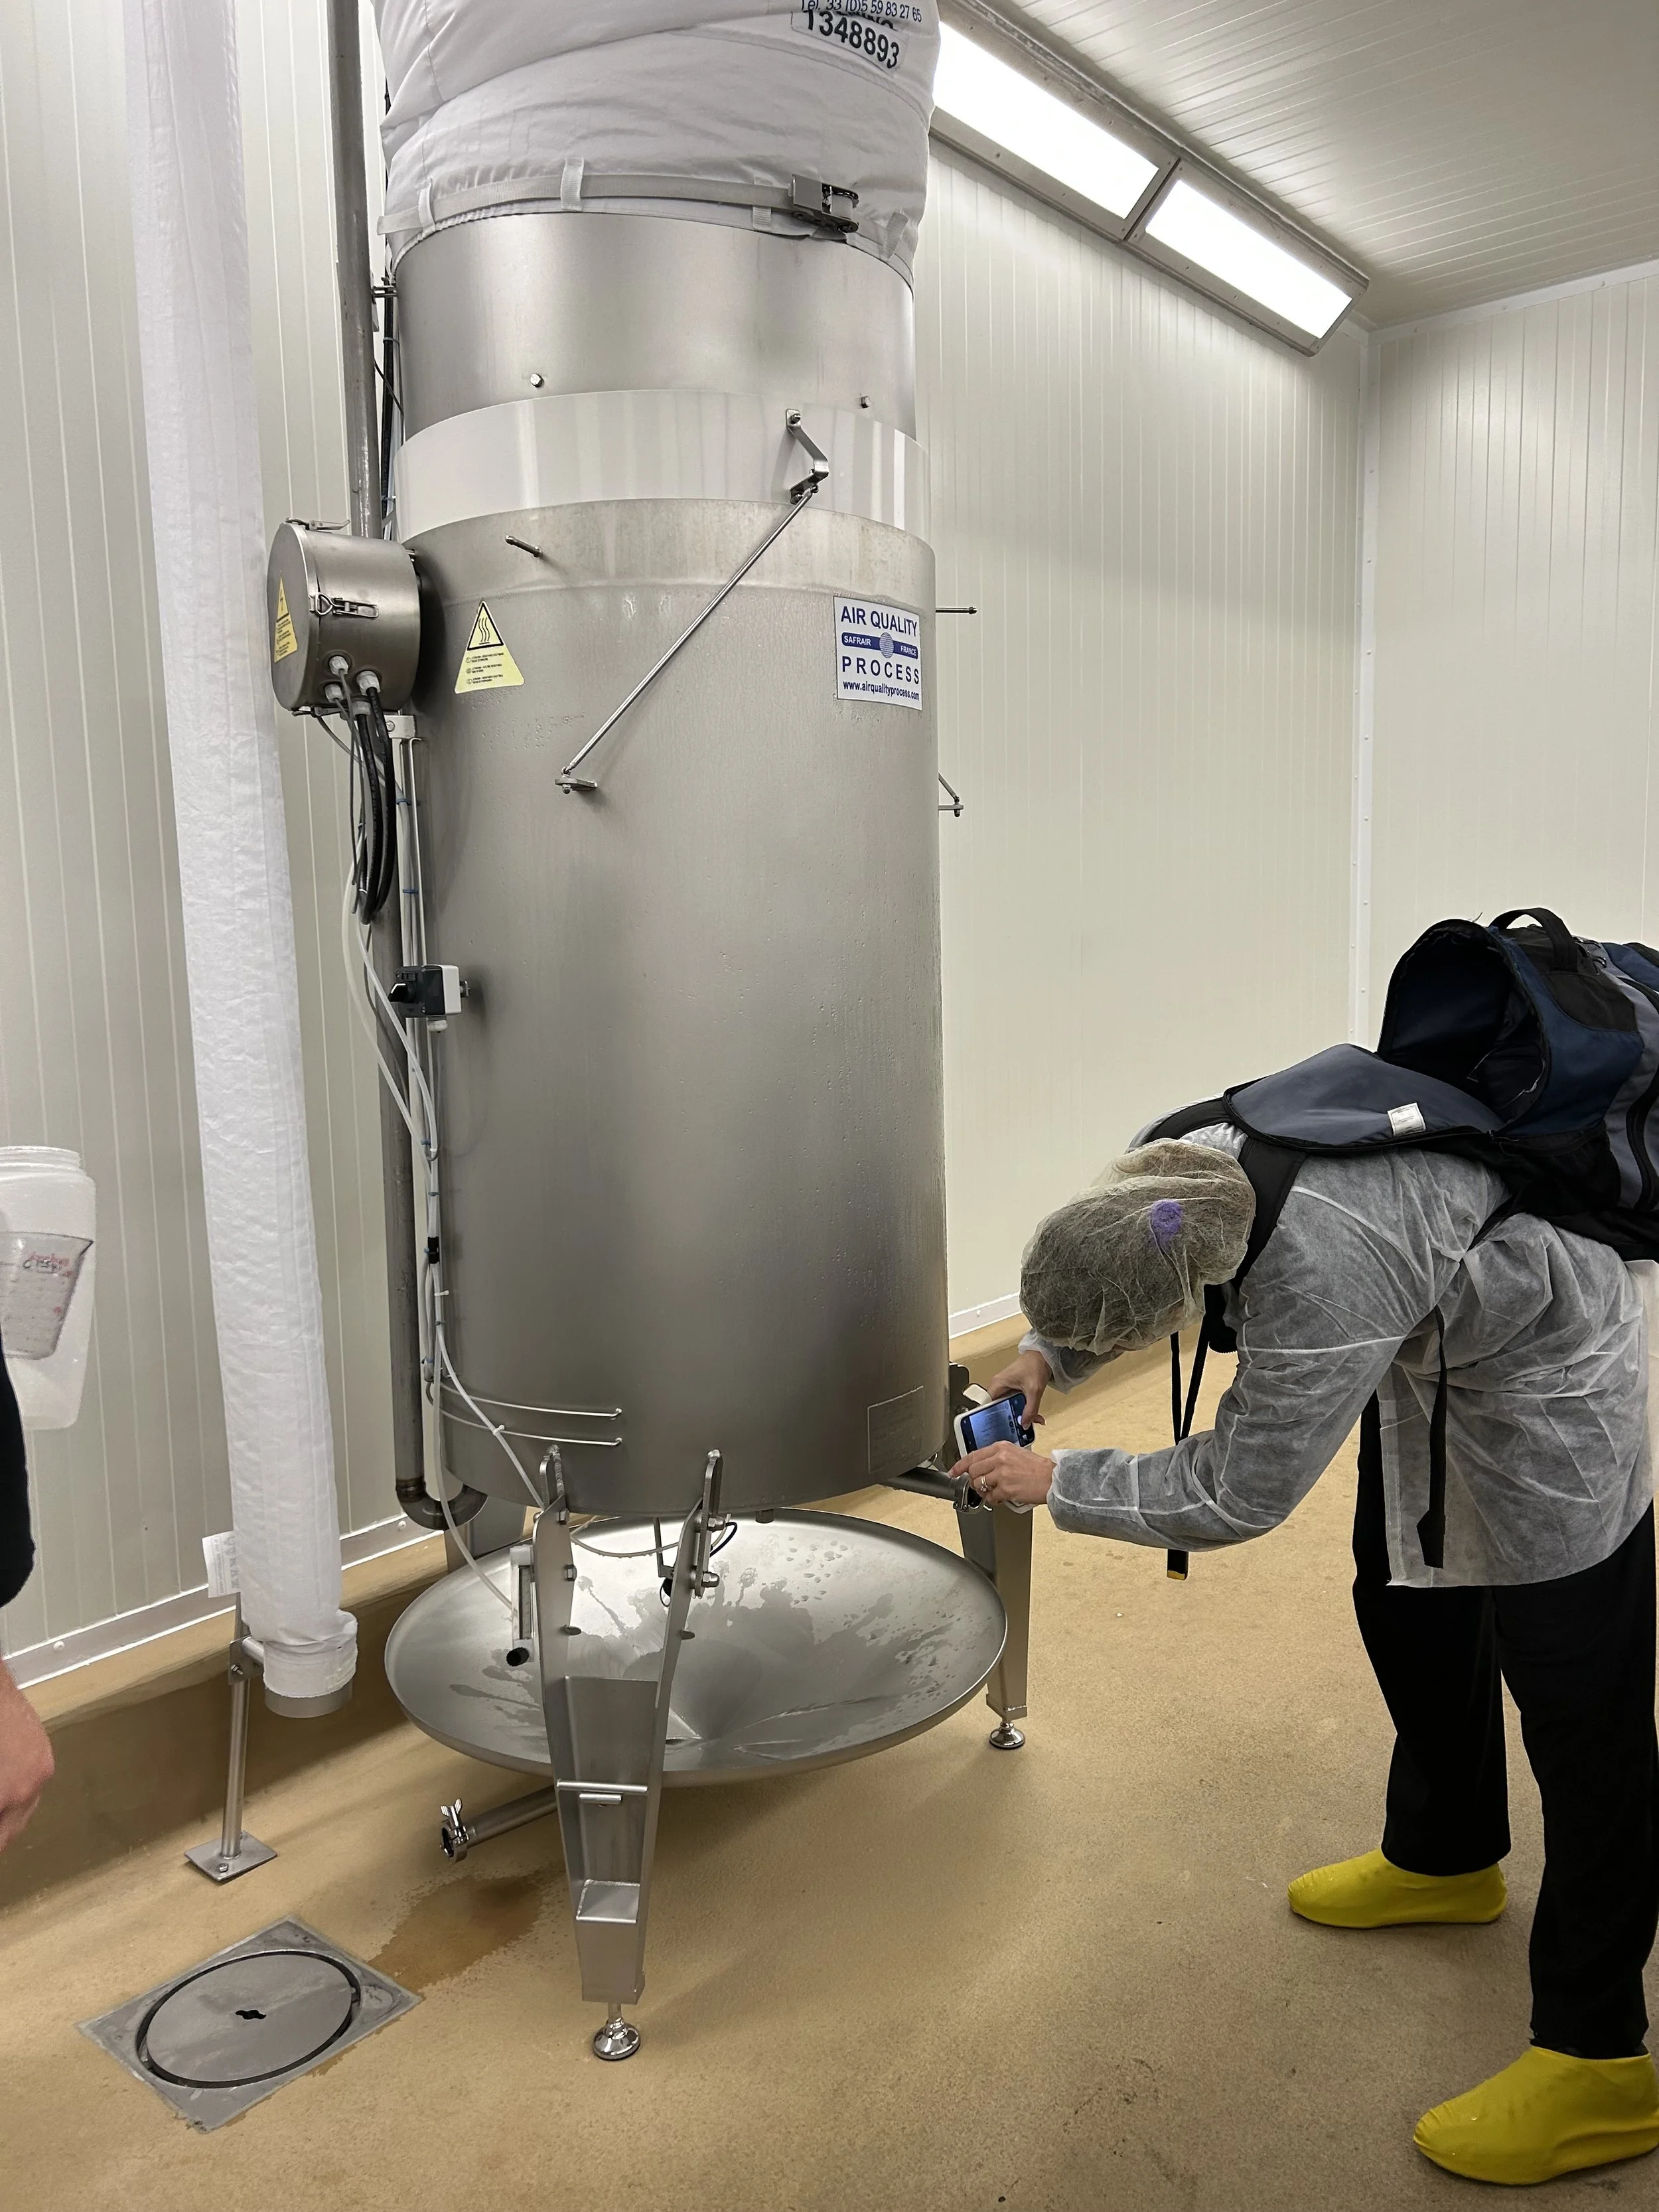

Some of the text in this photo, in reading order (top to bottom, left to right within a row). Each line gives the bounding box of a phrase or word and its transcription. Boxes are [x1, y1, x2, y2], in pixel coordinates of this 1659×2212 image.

[826, 0, 841, 10] 33
[871, 0, 883, 14] 59
[885, 1, 897, 17] 83
[899, 4, 910, 19] 27
[912, 7, 922, 23] 65
[802, 10, 899, 68] 1348893
[841, 606, 917, 636] AIR QUALITY
[843, 635, 917, 656] SAFRAIR FRANCE
[842, 656, 919, 684] PROCESS
[843, 680, 920, 700] www.airqualityprocess.com
